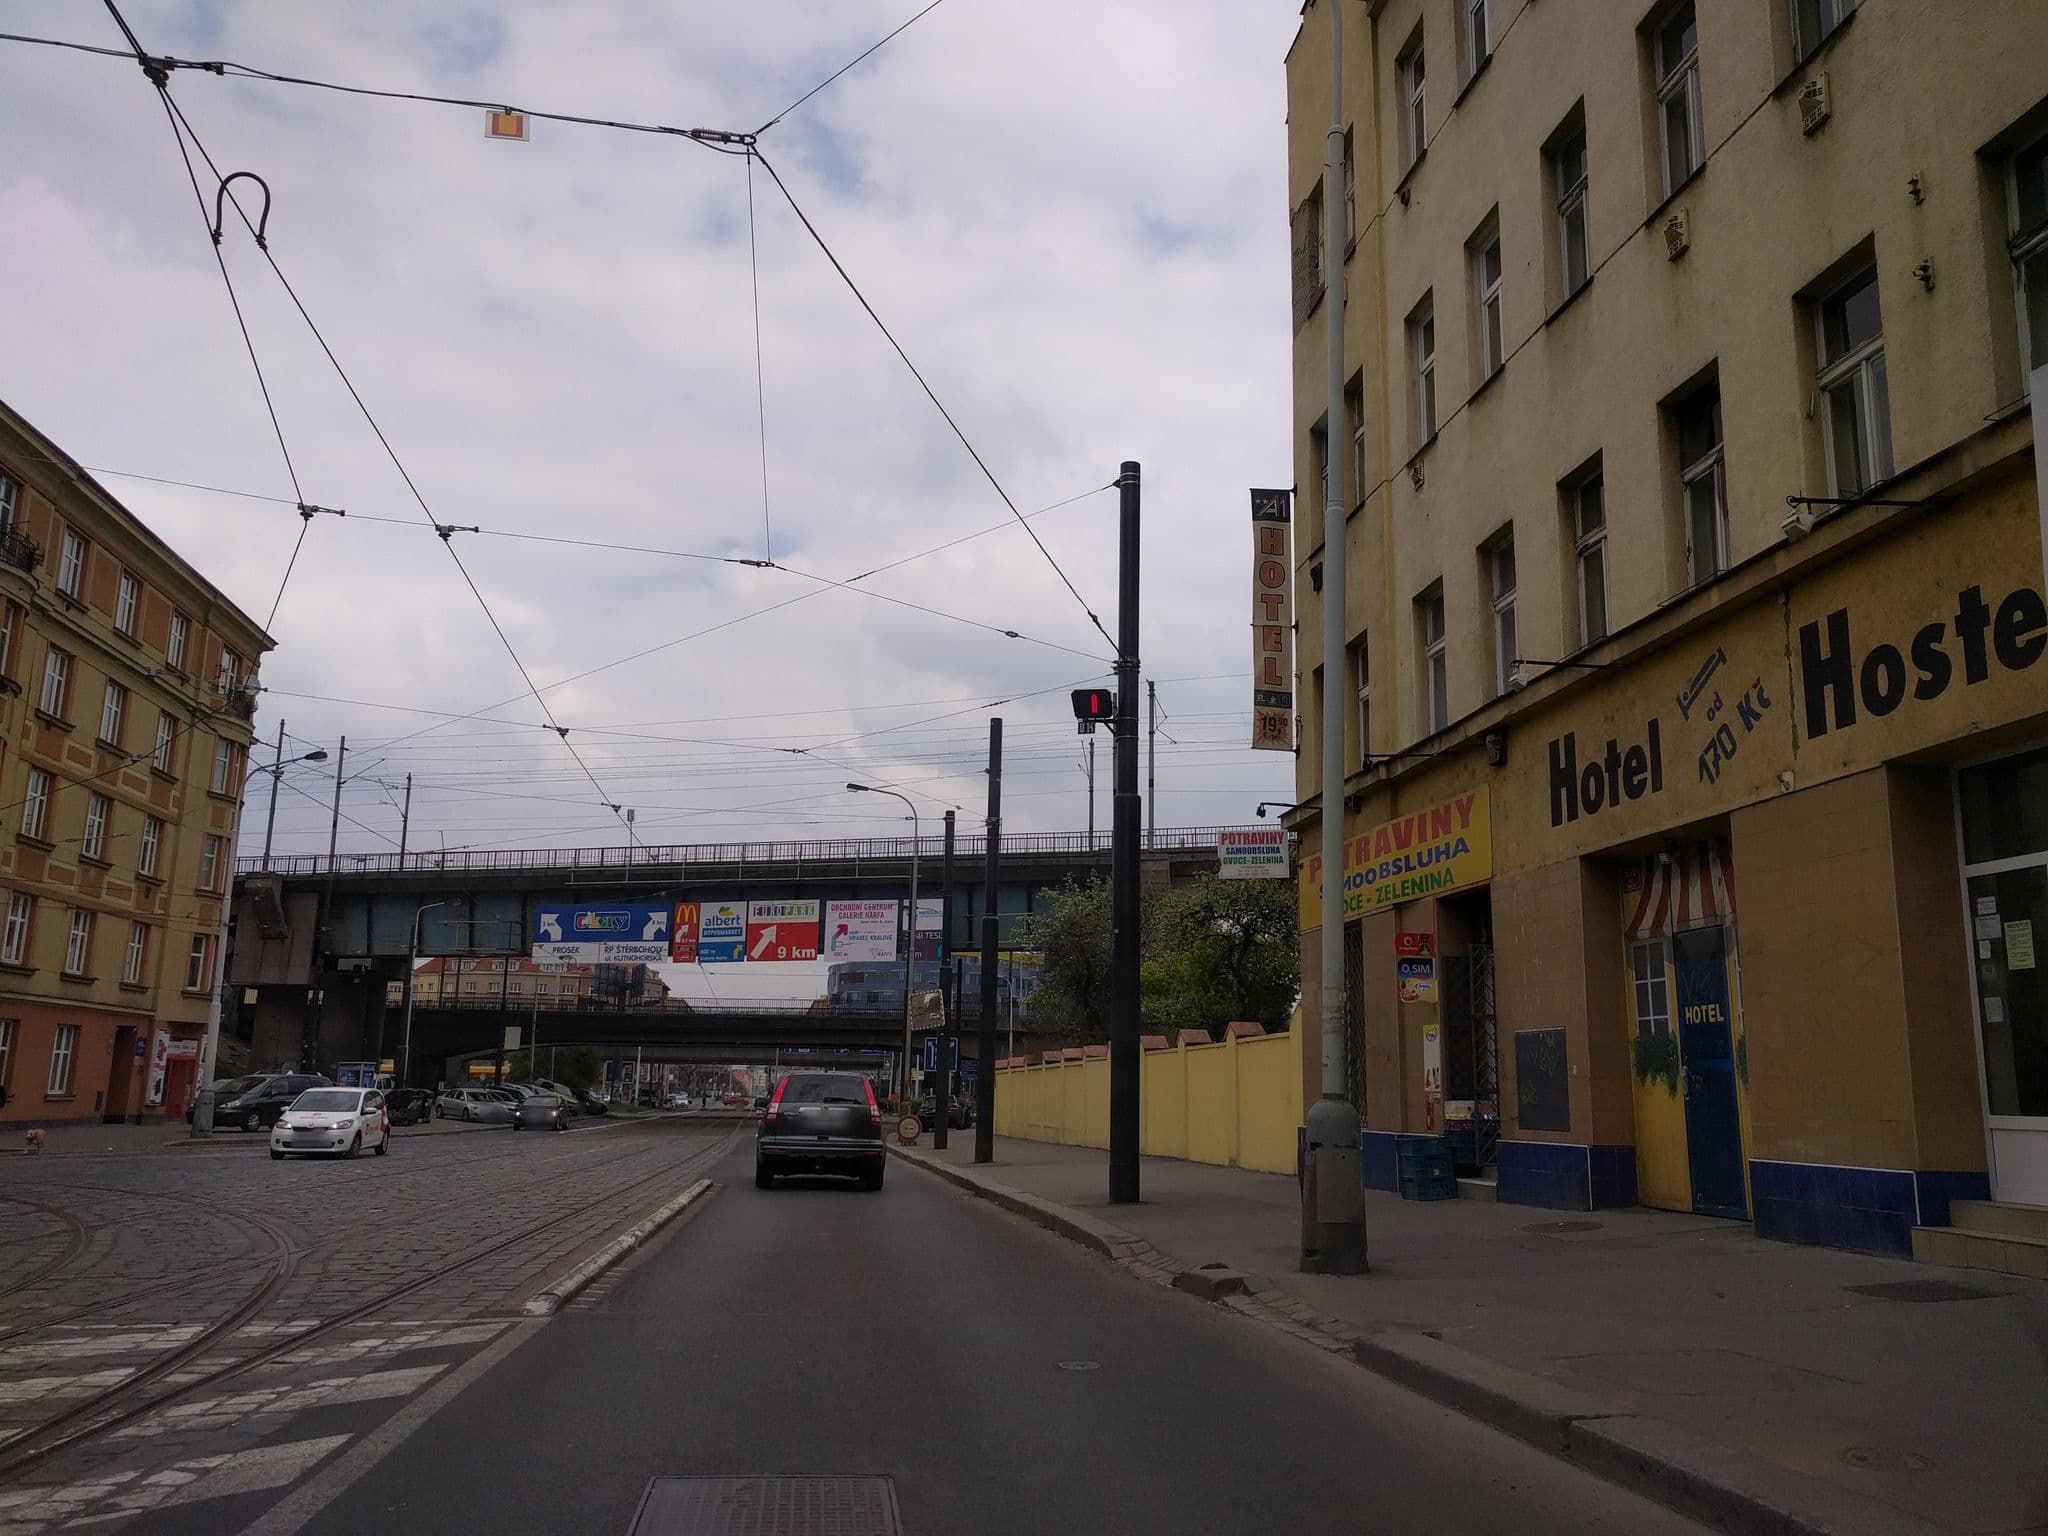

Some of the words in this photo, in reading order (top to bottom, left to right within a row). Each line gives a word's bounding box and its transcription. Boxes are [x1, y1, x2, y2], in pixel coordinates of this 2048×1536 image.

[1258, 526, 1286, 686] HOTEL
[1705, 691, 1724, 721] od
[1698, 722, 1738, 785] 170
[1736, 676, 1772, 733] Kč
[1548, 717, 1663, 828] Hotel
[1221, 832, 1285, 845] POTRAVINY
[1308, 792, 1474, 884] PTRAVINY
[1225, 846, 1281, 855] SAMOOBSLUHA
[1251, 856, 1284, 864] ZELENINA
[1320, 836, 1471, 900] MOOBSLUHA
[1375, 868, 1455, 905] ZELENINA
[831, 904, 863, 912] OBCHODNÍ
[864, 903, 893, 911] CENTRUM
[705, 914, 741, 926] albert
[865, 911, 885, 919] HARFA
[703, 928, 742, 936] HYPERMARKET
[552, 946, 580, 954] PROSEK
[777, 946, 787, 959] 9
[792, 945, 816, 958] km
[1412, 964, 1430, 974] SIM
[1684, 1003, 1725, 1025] HOTEL
